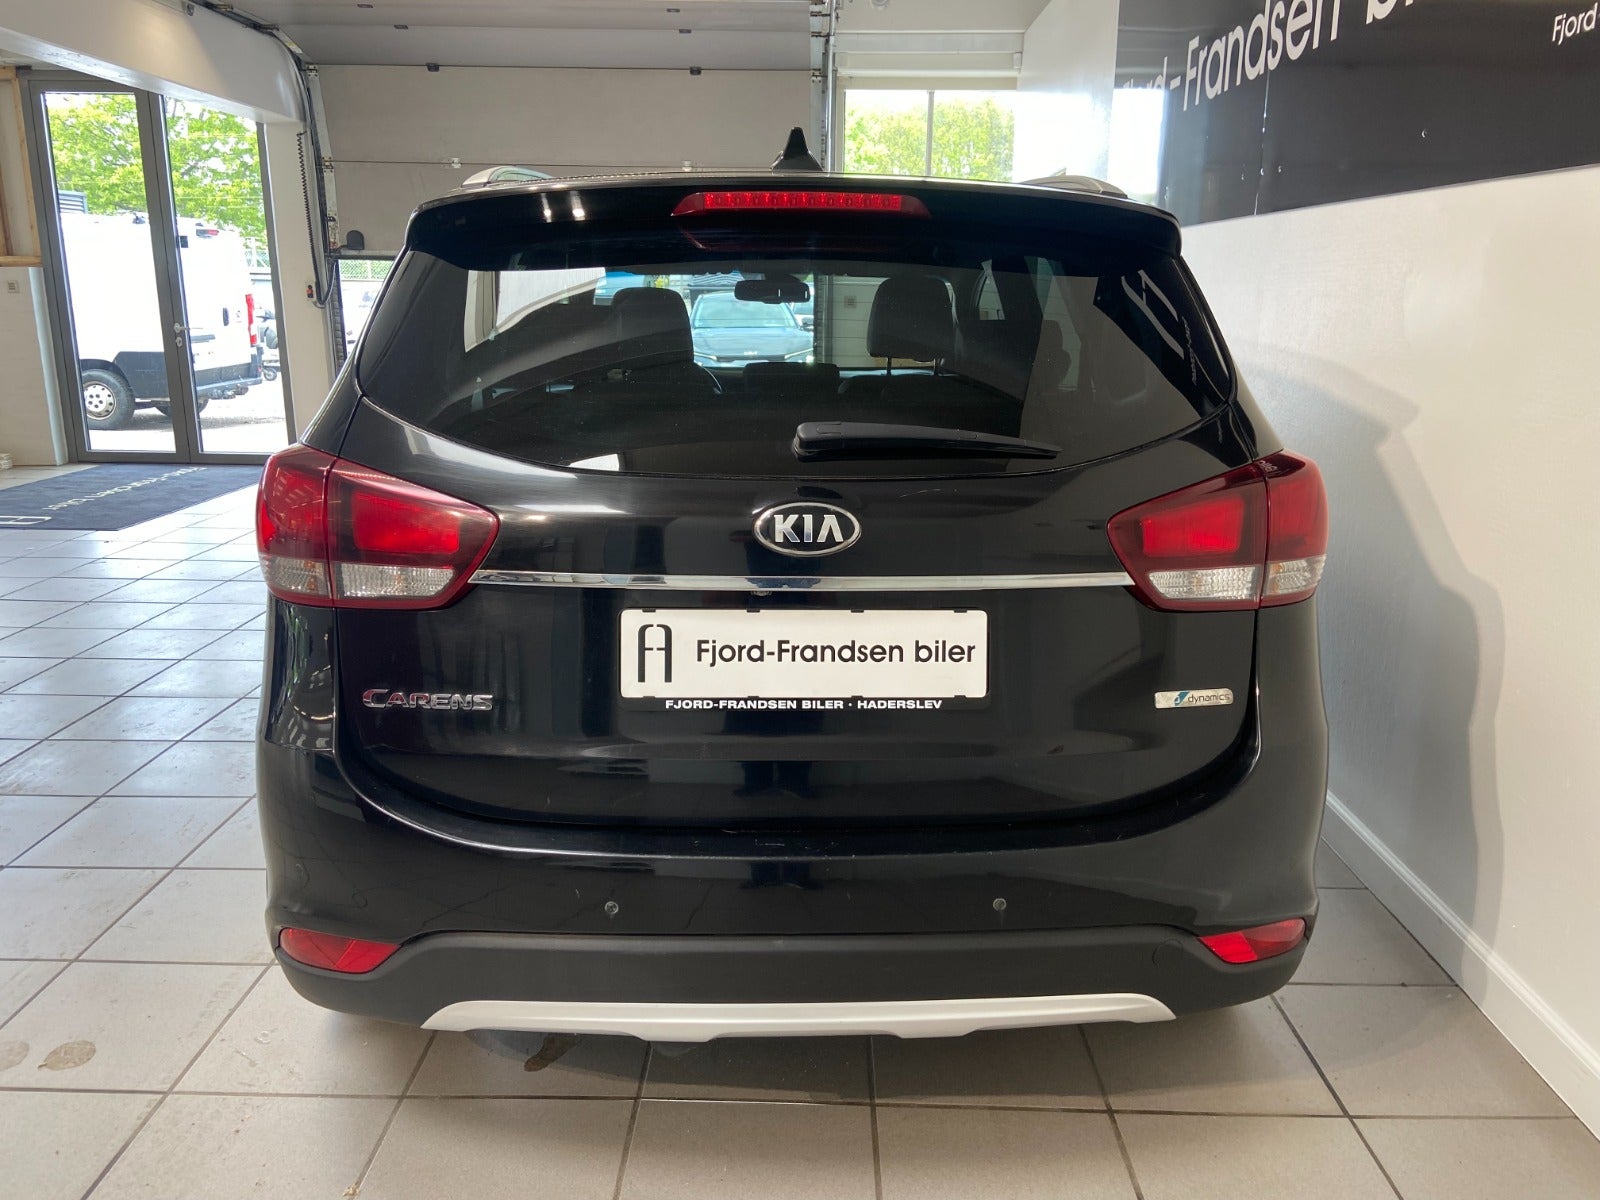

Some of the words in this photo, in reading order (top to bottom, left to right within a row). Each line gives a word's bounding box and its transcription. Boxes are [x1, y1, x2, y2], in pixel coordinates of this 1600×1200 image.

[774, 514, 844, 542] KIA
[696, 639, 904, 668] Fjord-Frandsen
[914, 639, 976, 663] biler
[362, 688, 494, 711] CARENS
[665, 700, 797, 710] FJORD-FRANDSEN
[801, 700, 844, 710] BILER
[857, 700, 943, 710] HADERSLEV
[1187, 693, 1230, 704] dynamics
